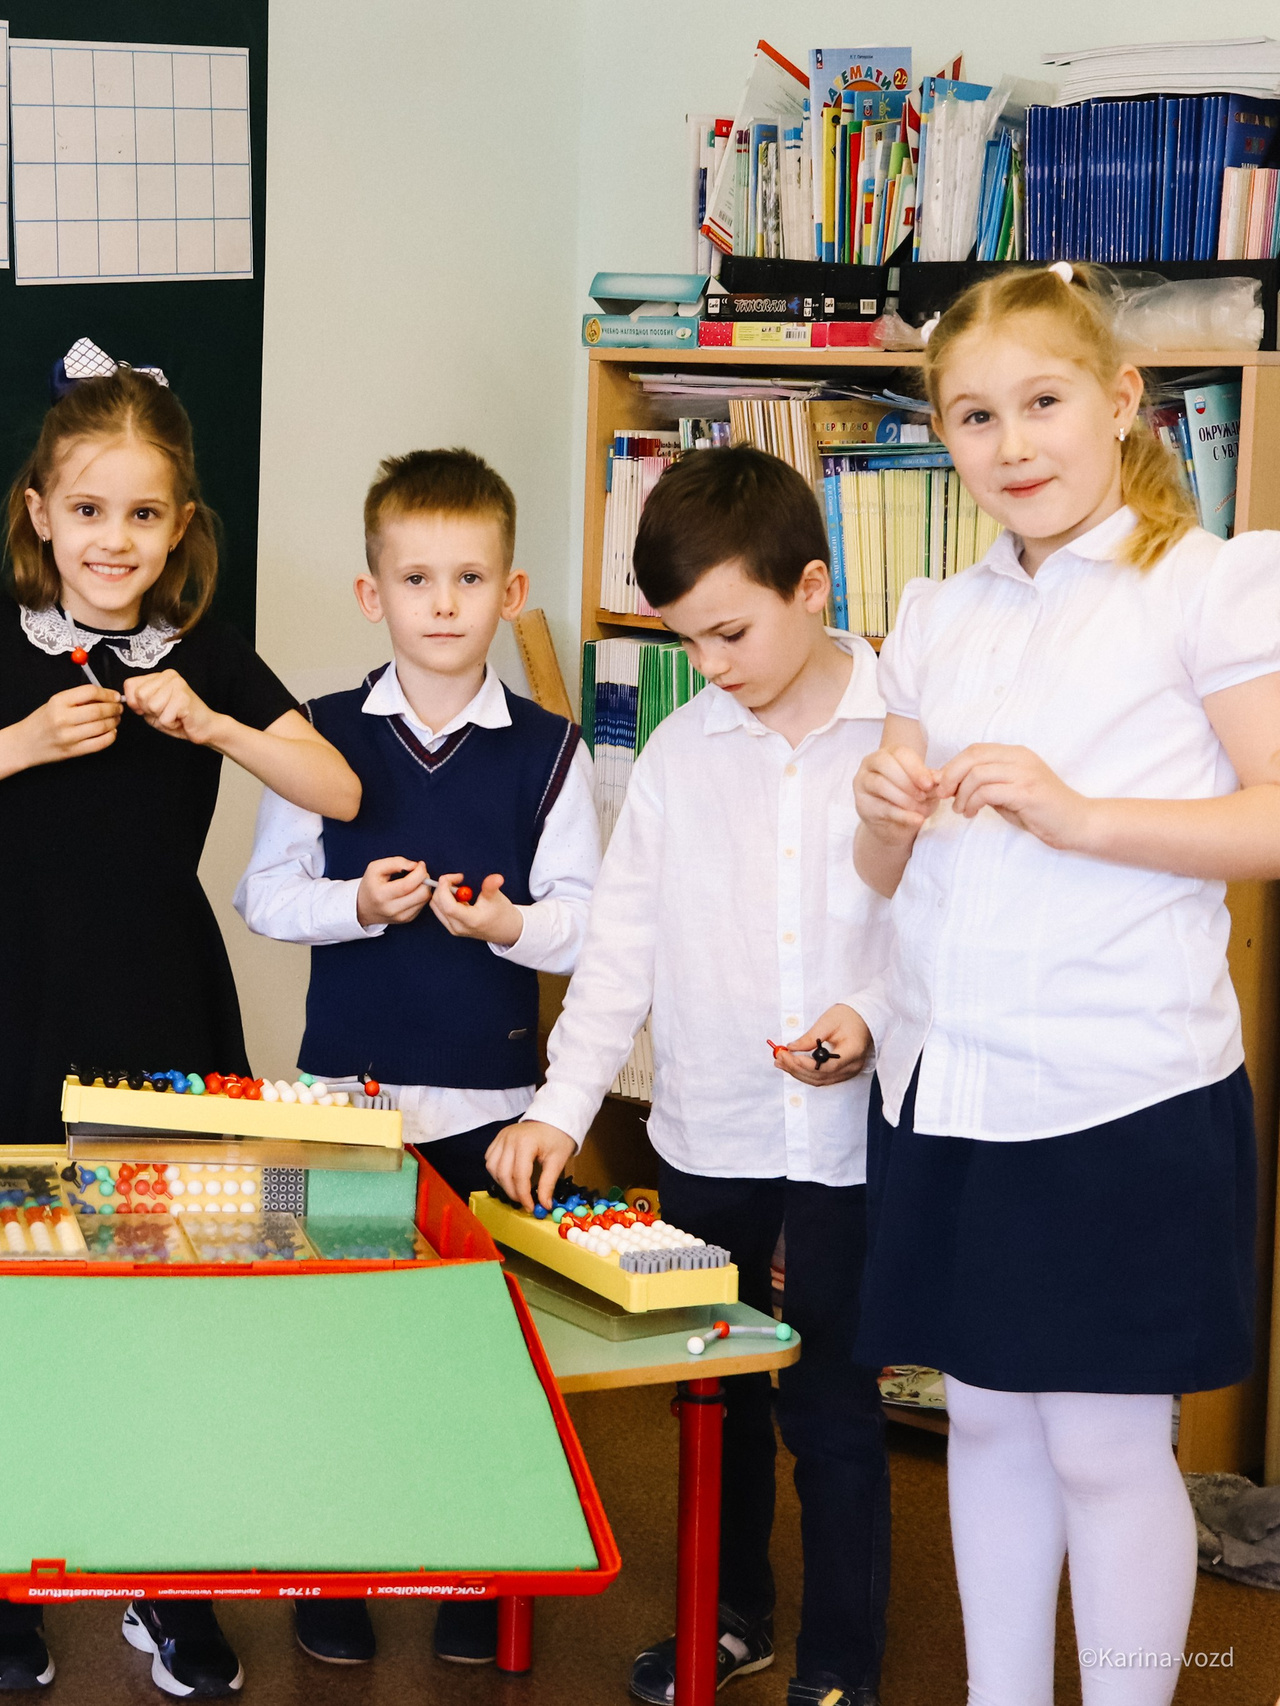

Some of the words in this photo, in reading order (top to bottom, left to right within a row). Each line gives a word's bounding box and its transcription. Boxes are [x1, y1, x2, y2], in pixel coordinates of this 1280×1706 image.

[734, 298, 787, 313] TANGRAM
[886, 422, 899, 443] 2
[1213, 446, 1220, 461] С
[278, 1587, 322, 1596] 31764
[377, 1586, 486, 1596] CVK-Molekülbox
